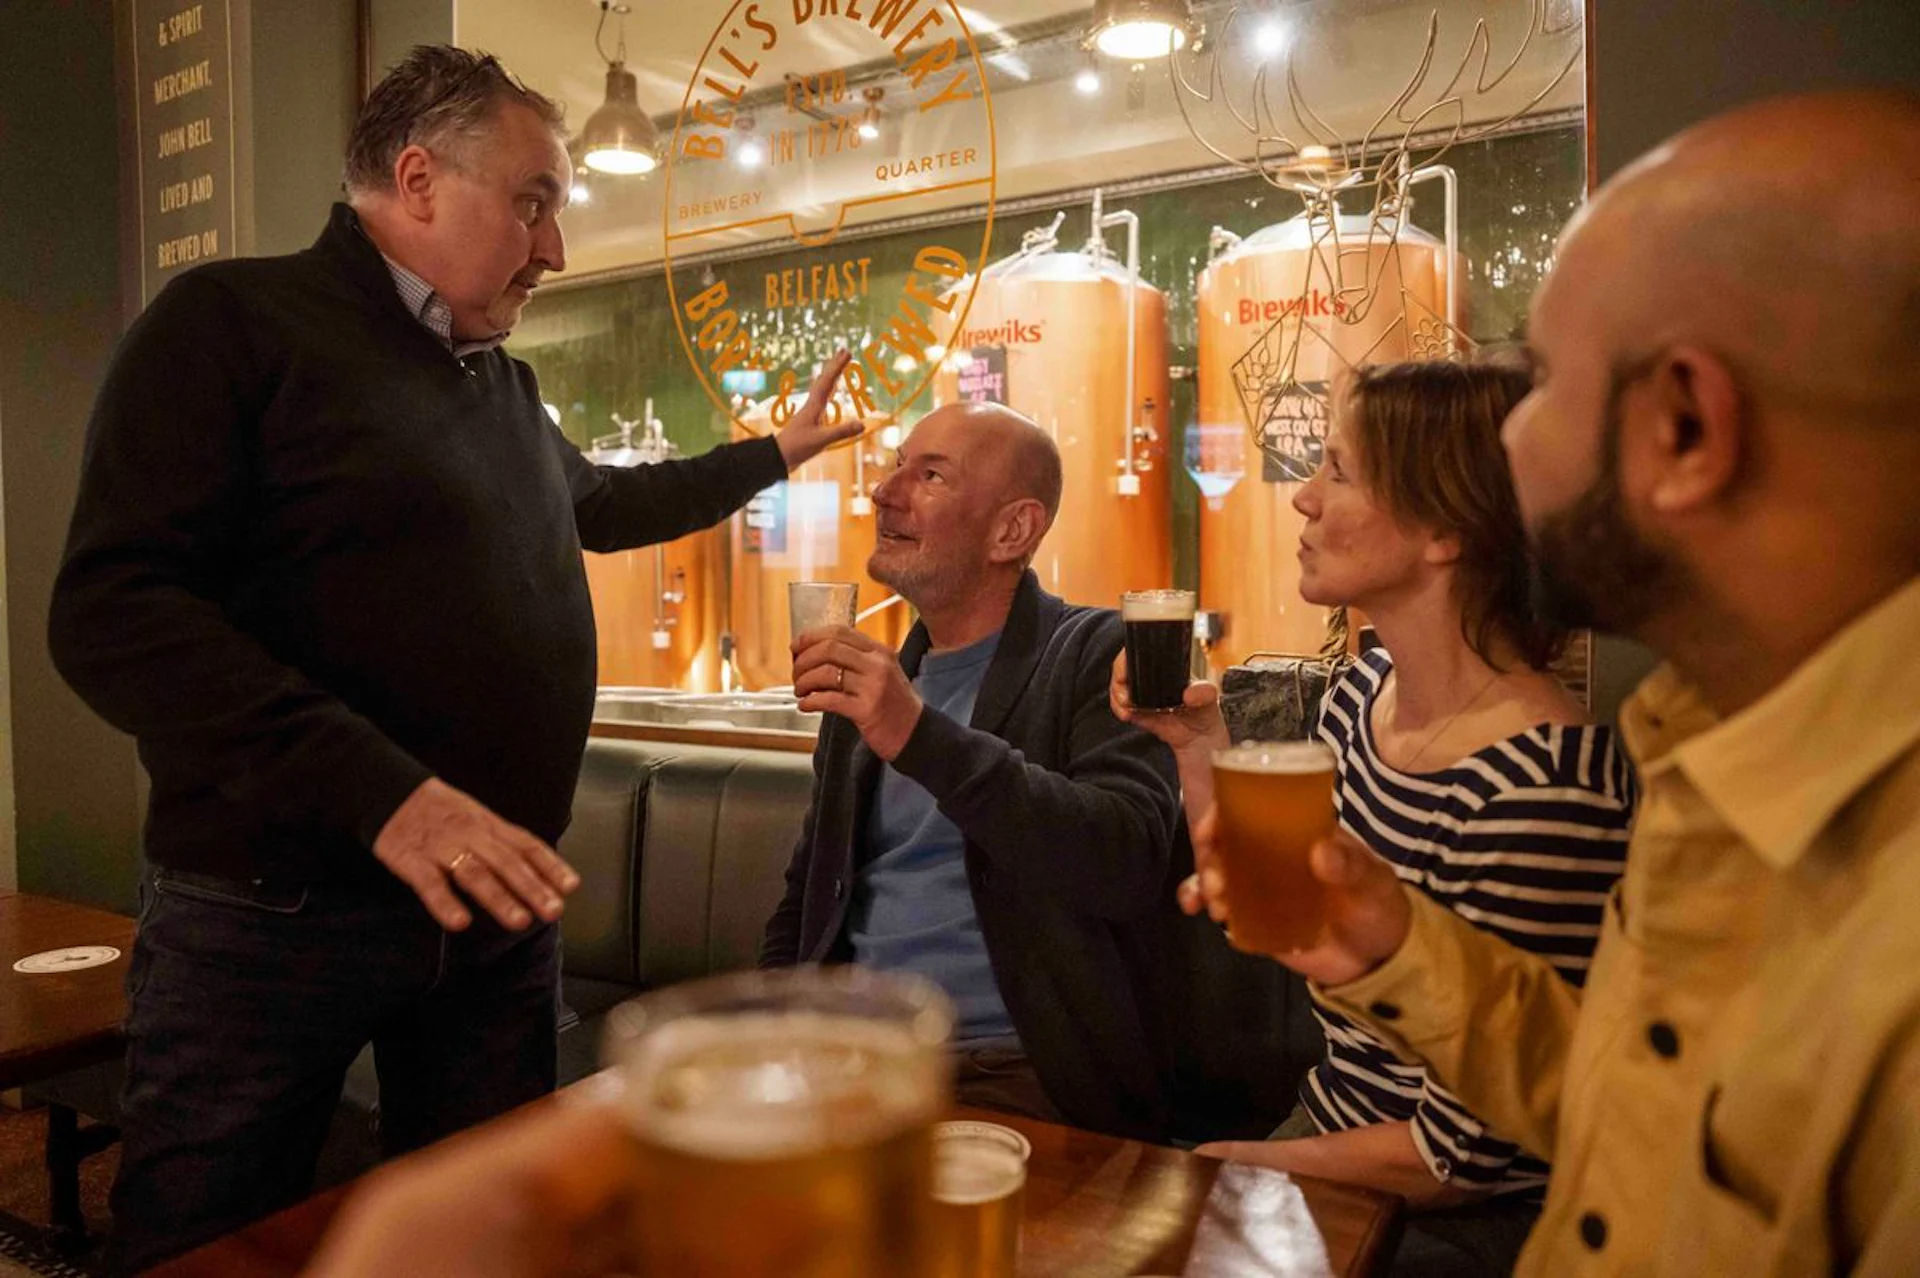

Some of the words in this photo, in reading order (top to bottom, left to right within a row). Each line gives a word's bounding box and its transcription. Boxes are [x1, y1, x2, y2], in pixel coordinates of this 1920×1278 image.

[159, 22, 168, 47] &
[169, 4, 203, 42] SPIRIT
[155, 60, 212, 105] MERCHANT.
[684, 3, 777, 160] BELL'S
[158, 127, 185, 159] JOHN
[187, 118, 213, 149] BELL
[770, 128, 794, 167] IN
[875, 148, 976, 181] QUARTER
[160, 182, 188, 214] LIVED
[191, 174, 214, 205] AND
[679, 190, 763, 220] BREWERY
[158, 234, 201, 269] BREWED
[202, 229, 218, 257] ON
[766, 258, 871, 309] BELFAST
[771, 369, 797, 428] &
